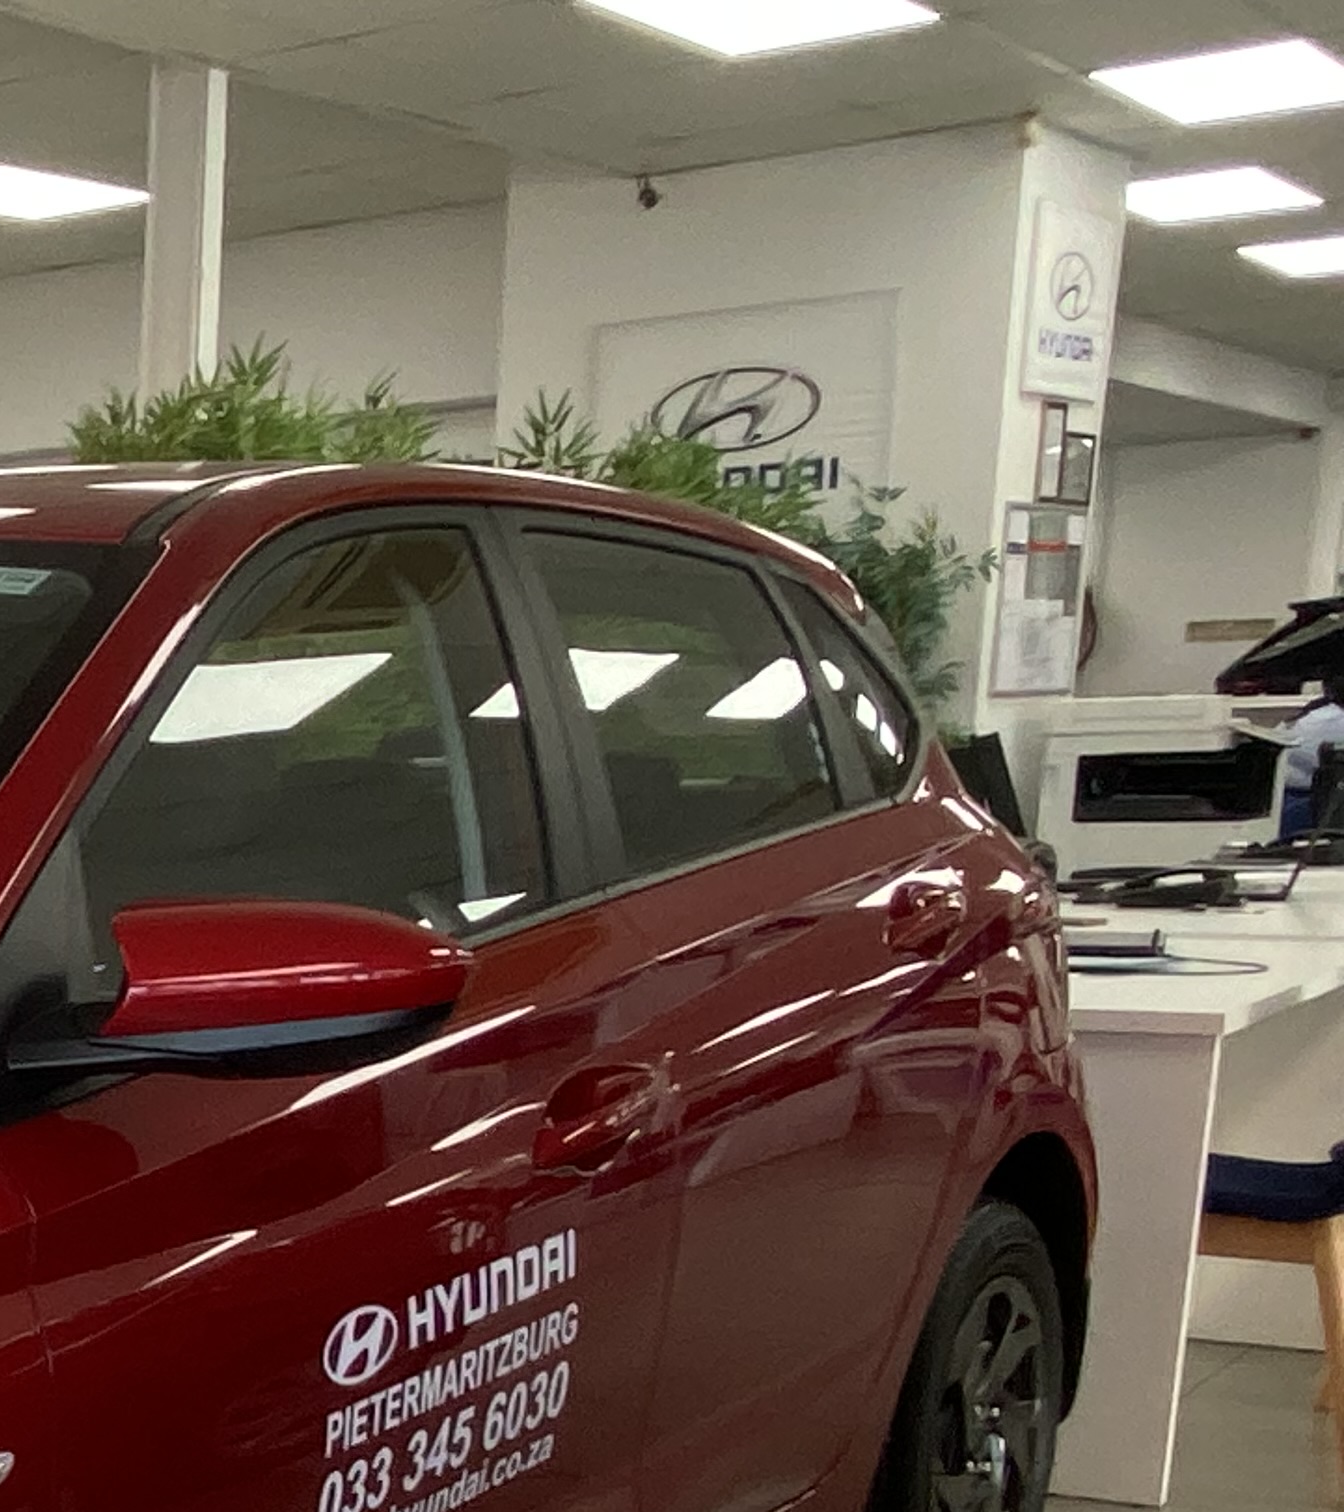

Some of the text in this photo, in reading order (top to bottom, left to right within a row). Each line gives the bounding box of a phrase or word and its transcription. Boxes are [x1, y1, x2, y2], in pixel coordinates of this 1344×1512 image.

[406, 1228, 577, 1349] HYUNDAI
[324, 1302, 579, 1459] PIETERMARITZBURG
[402, 1405, 476, 1492] 345
[482, 1360, 570, 1451] 6030
